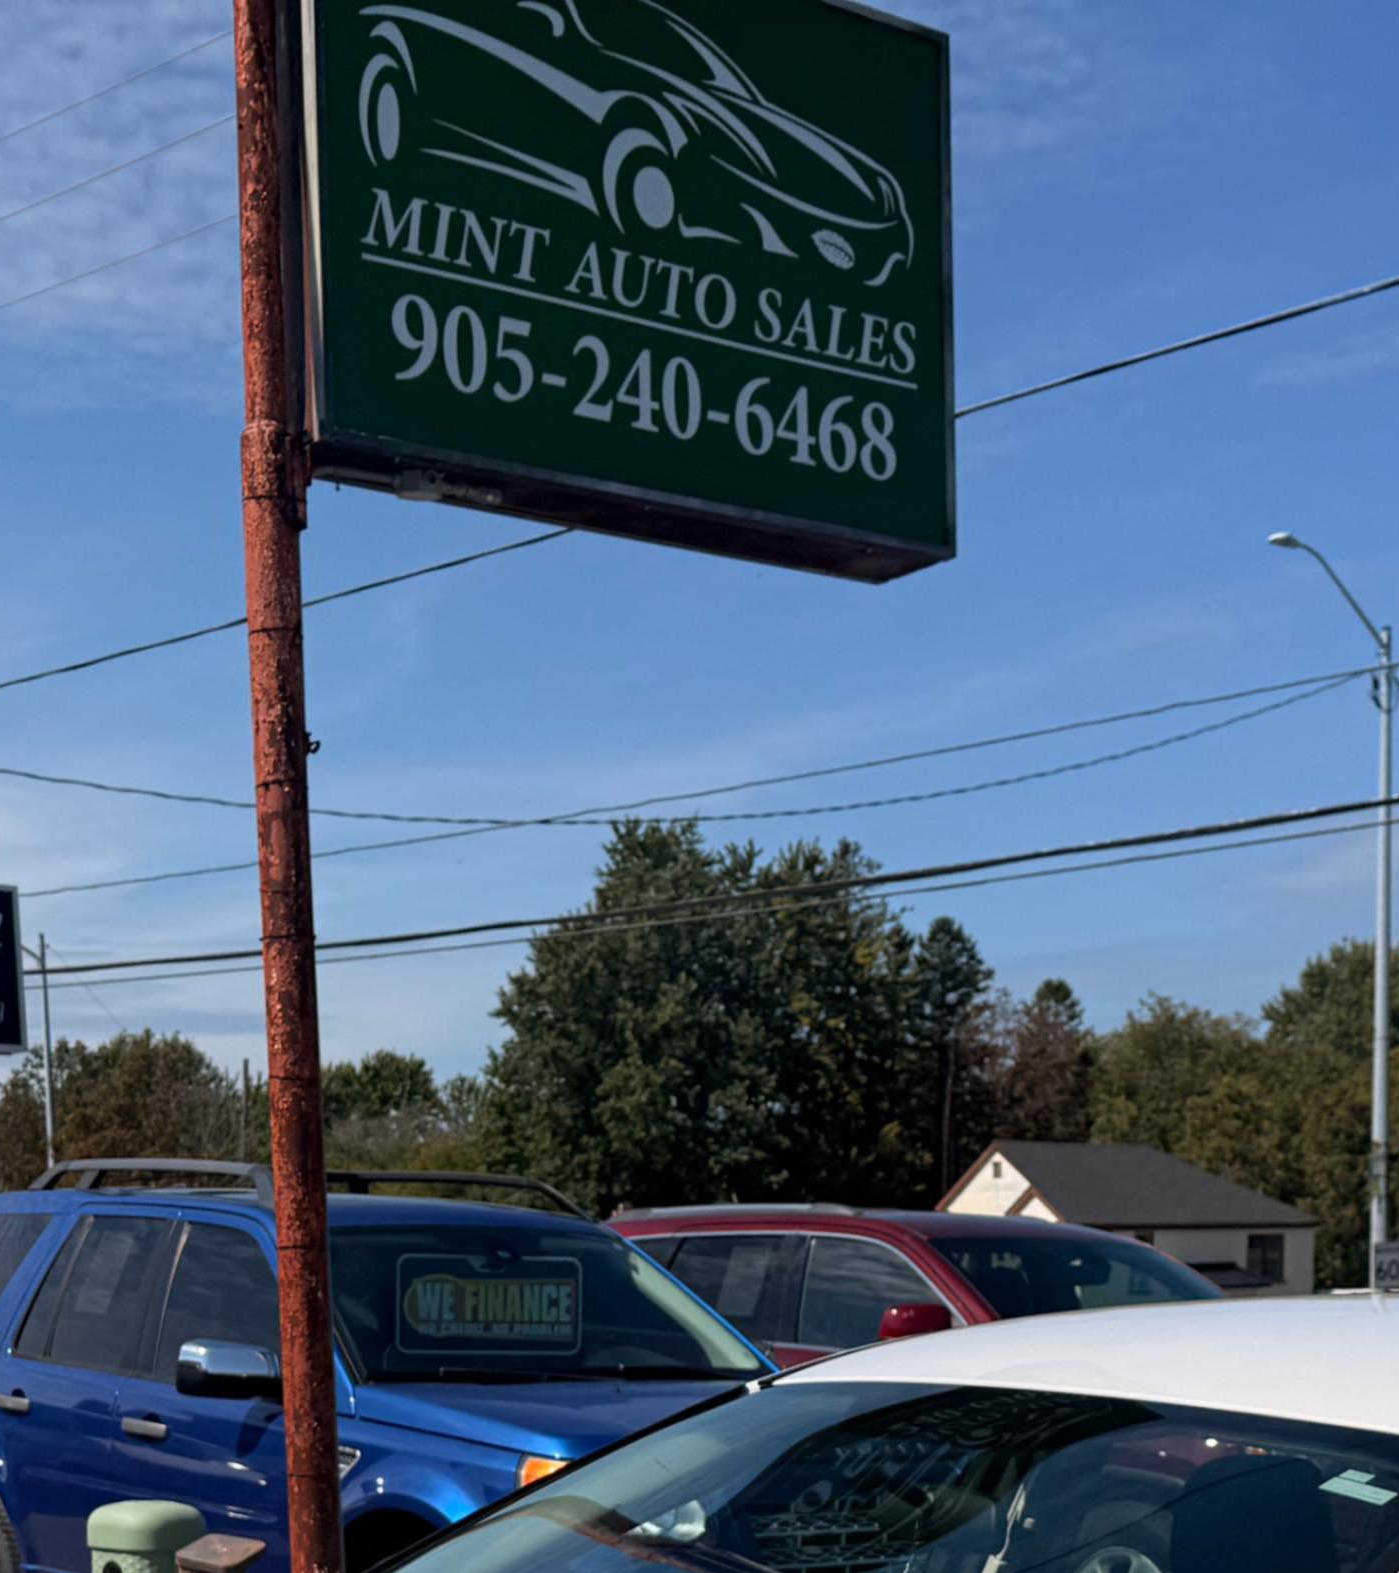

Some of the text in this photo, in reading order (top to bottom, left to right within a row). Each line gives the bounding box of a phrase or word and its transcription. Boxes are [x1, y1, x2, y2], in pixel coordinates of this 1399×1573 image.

[361, 188, 917, 374] MINT AUTO SALES
[391, 294, 898, 482] 905-240-6468
[417, 1283, 573, 1322] WE FINANCE
